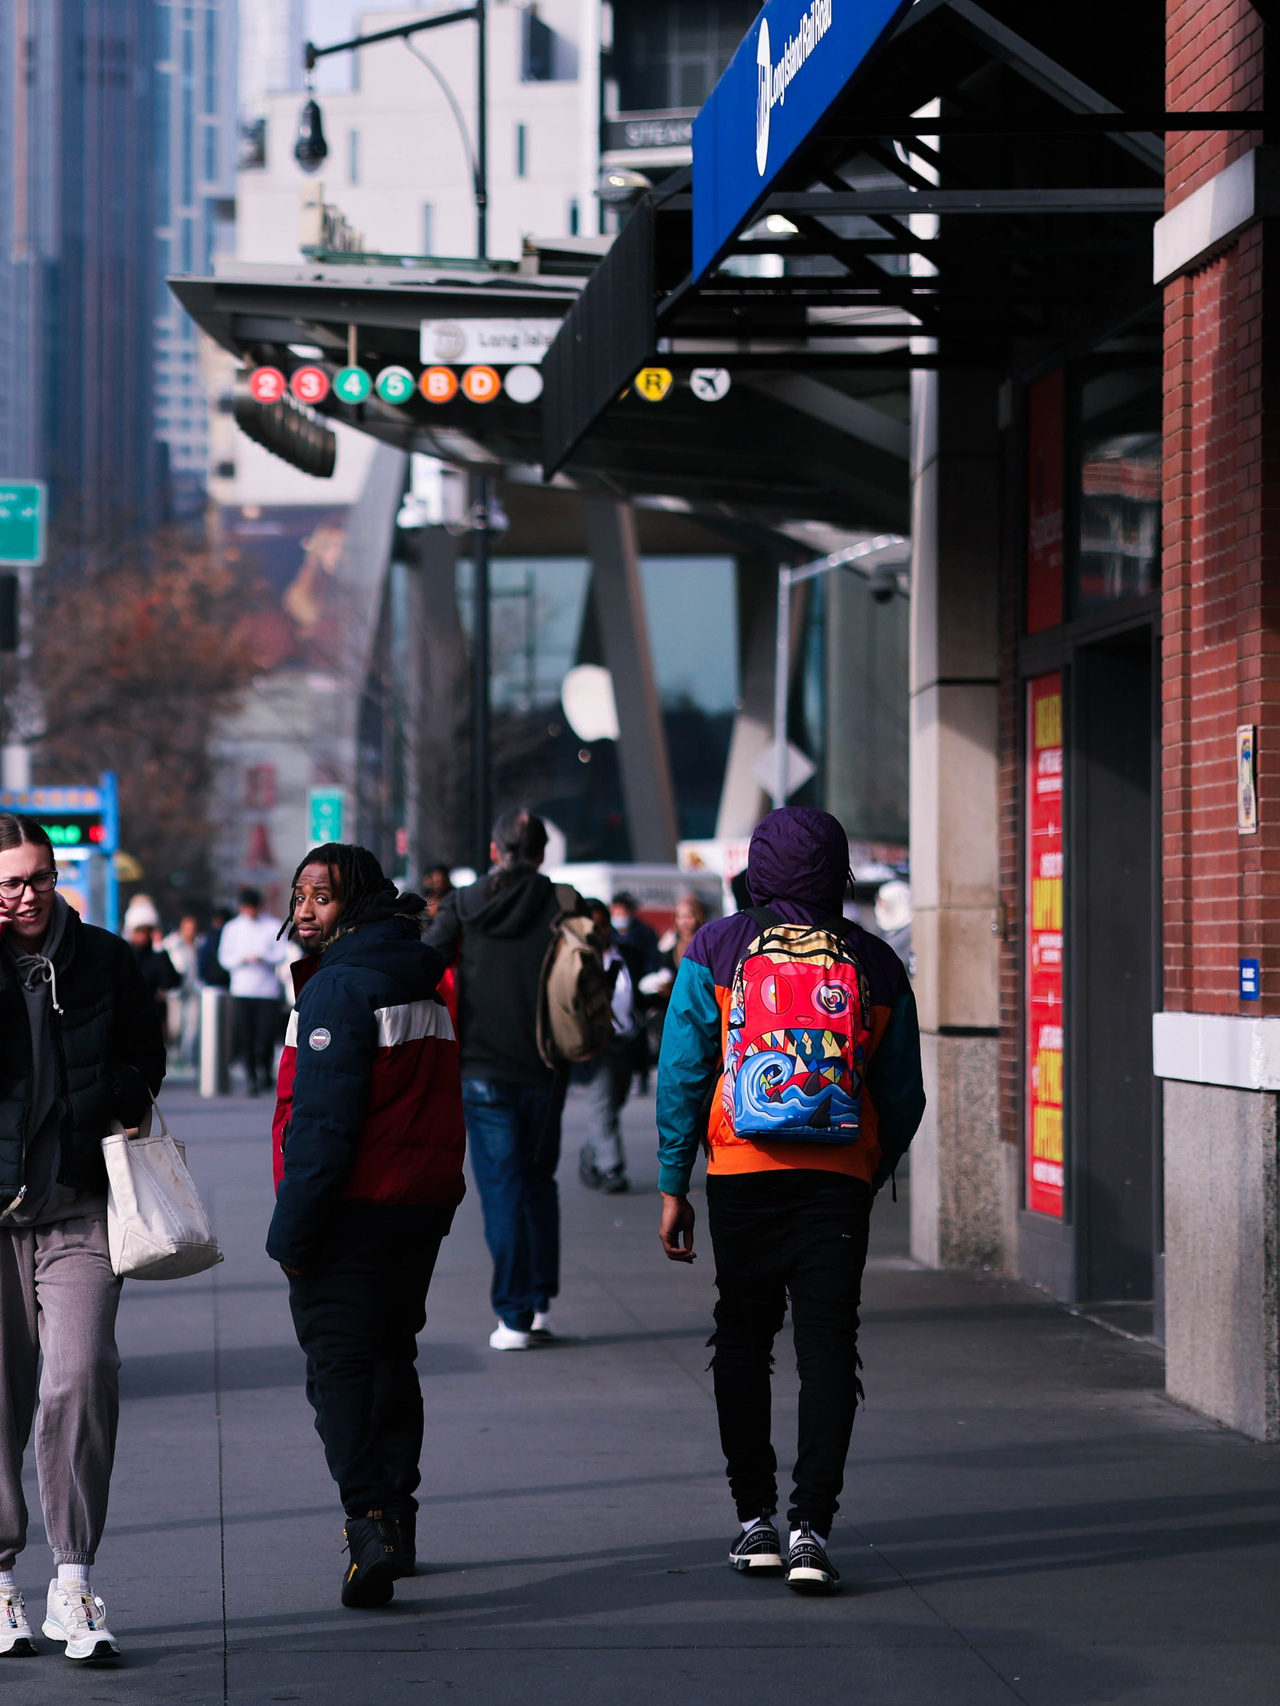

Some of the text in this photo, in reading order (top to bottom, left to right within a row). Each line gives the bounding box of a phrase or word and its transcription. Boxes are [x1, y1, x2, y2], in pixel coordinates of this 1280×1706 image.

[769, 57, 785, 109] Long
[785, 19, 802, 88] Island
[803, 1, 815, 62] Rail
[478, 332, 520, 351] Long
[257, 371, 493, 398] 2 3 4 5 B D
[646, 373, 662, 391] R
[383, 1545, 395, 1554] 23
